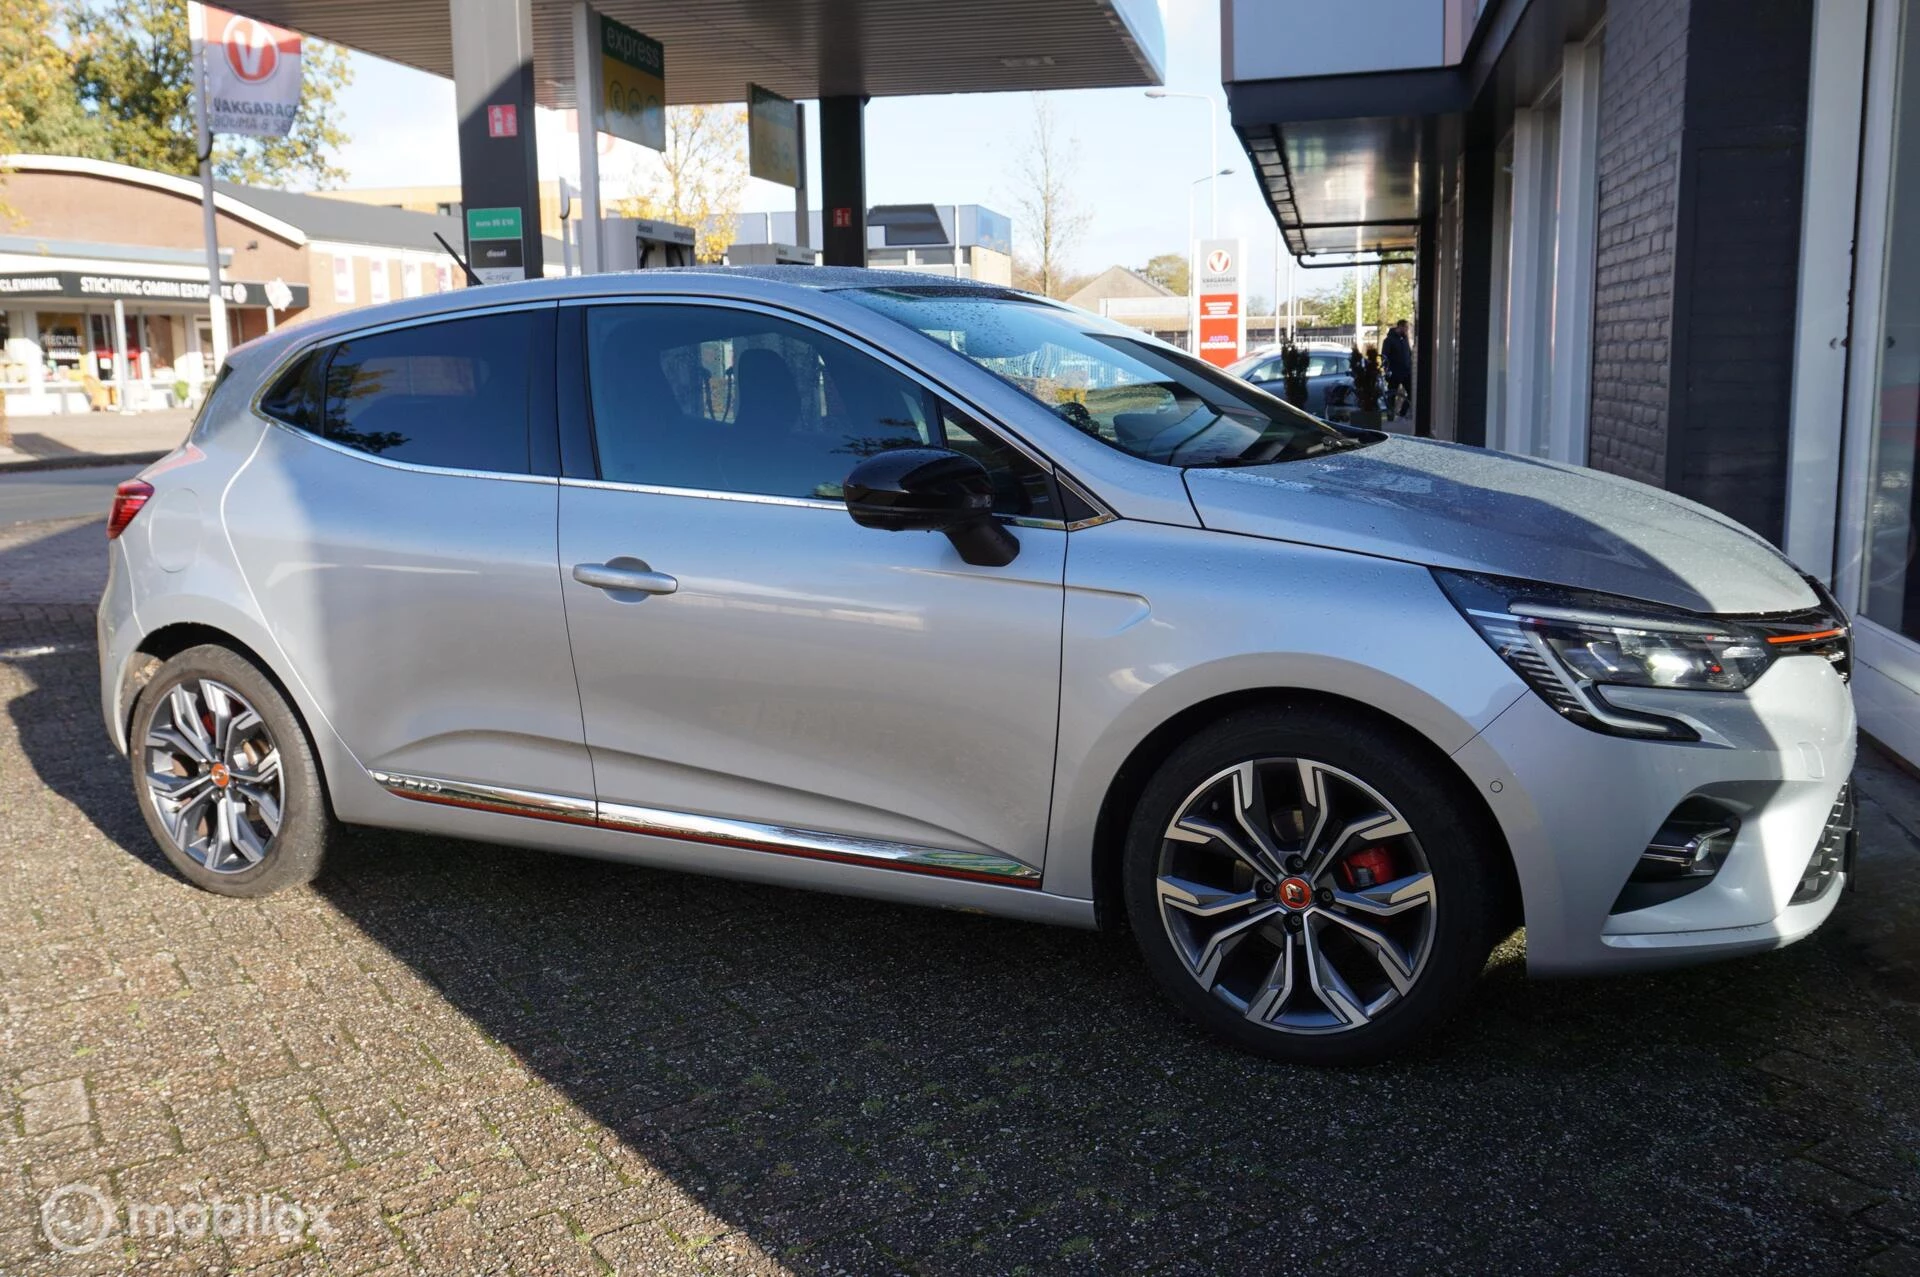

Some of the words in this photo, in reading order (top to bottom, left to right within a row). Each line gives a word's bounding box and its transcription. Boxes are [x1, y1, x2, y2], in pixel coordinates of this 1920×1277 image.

[606, 26, 659, 69] express
[80, 276, 142, 295] STICHTING
[142, 280, 180, 297] OMRIN
[181, 283, 233, 300] ESTAFTE
[45, 335, 82, 346] RECYCLE
